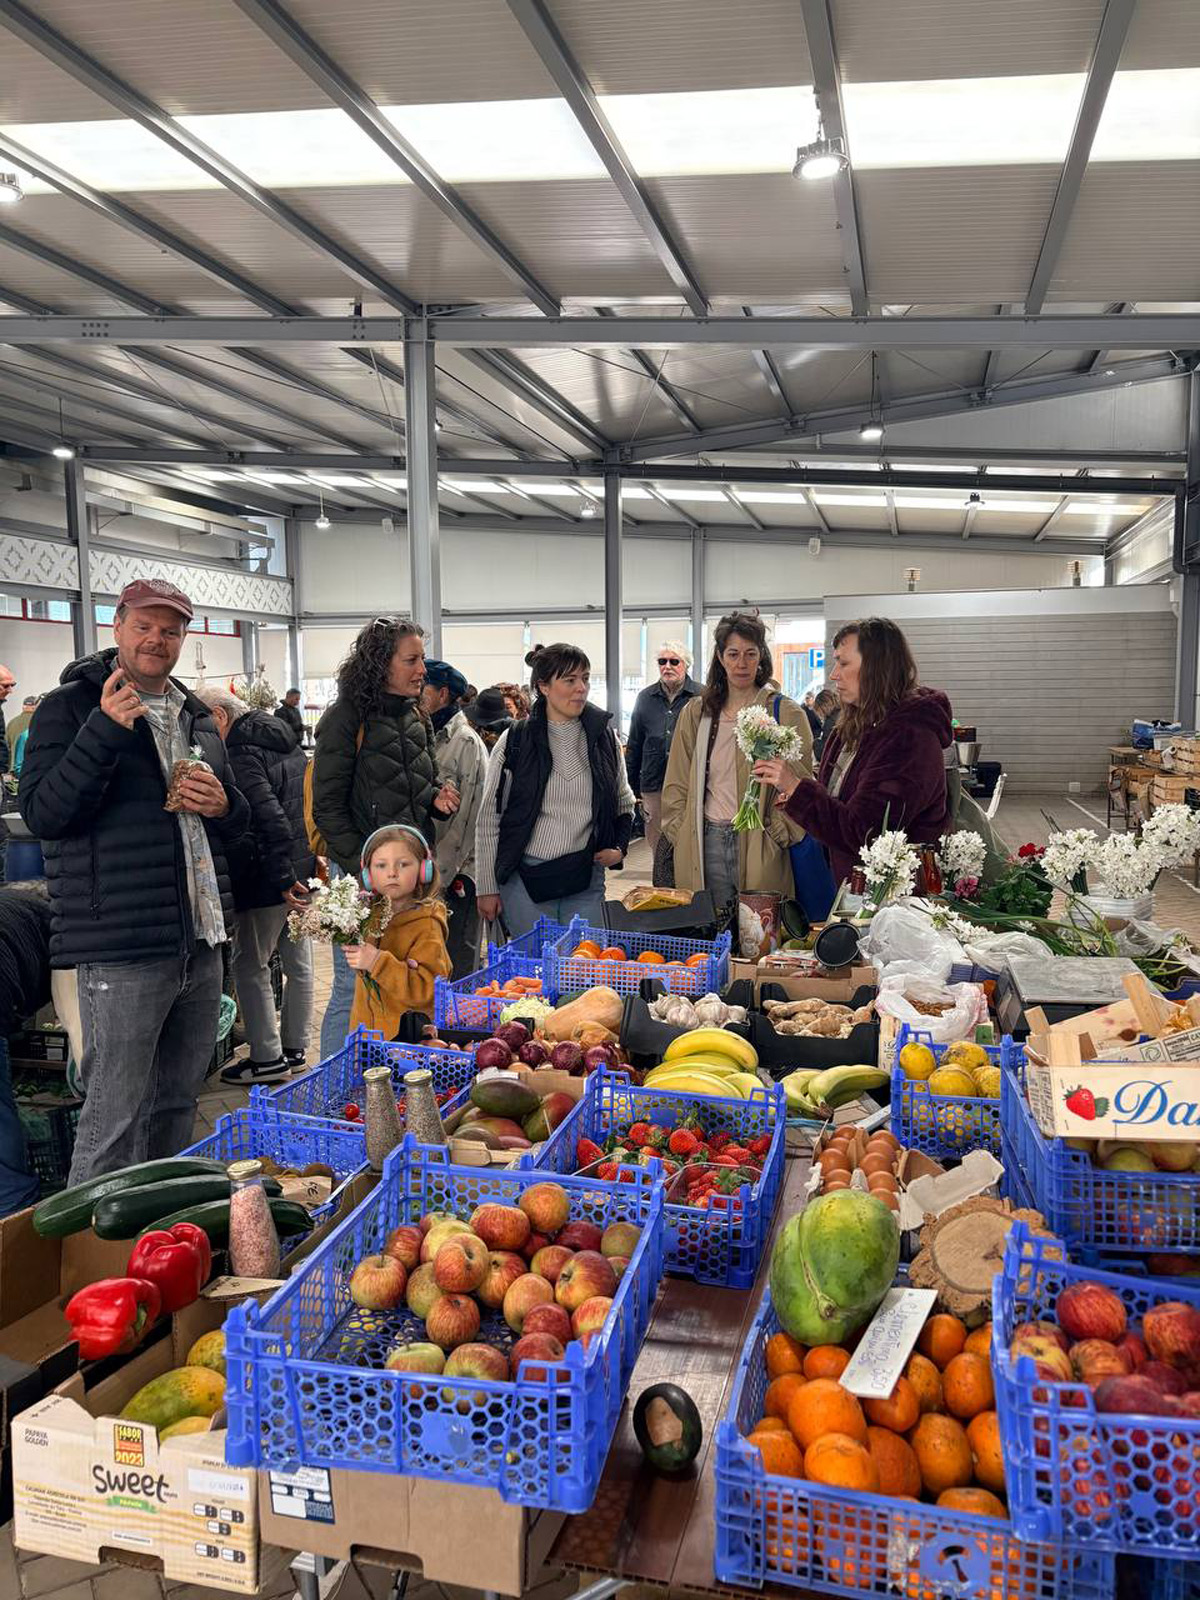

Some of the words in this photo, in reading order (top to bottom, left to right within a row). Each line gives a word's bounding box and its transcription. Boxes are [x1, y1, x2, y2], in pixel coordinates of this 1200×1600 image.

[1112, 1080, 1200, 1126] Da
[24, 1428, 48, 1439] PAPAYA
[119, 1426, 142, 1439] SABOR
[92, 1464, 170, 1504] Sweet
